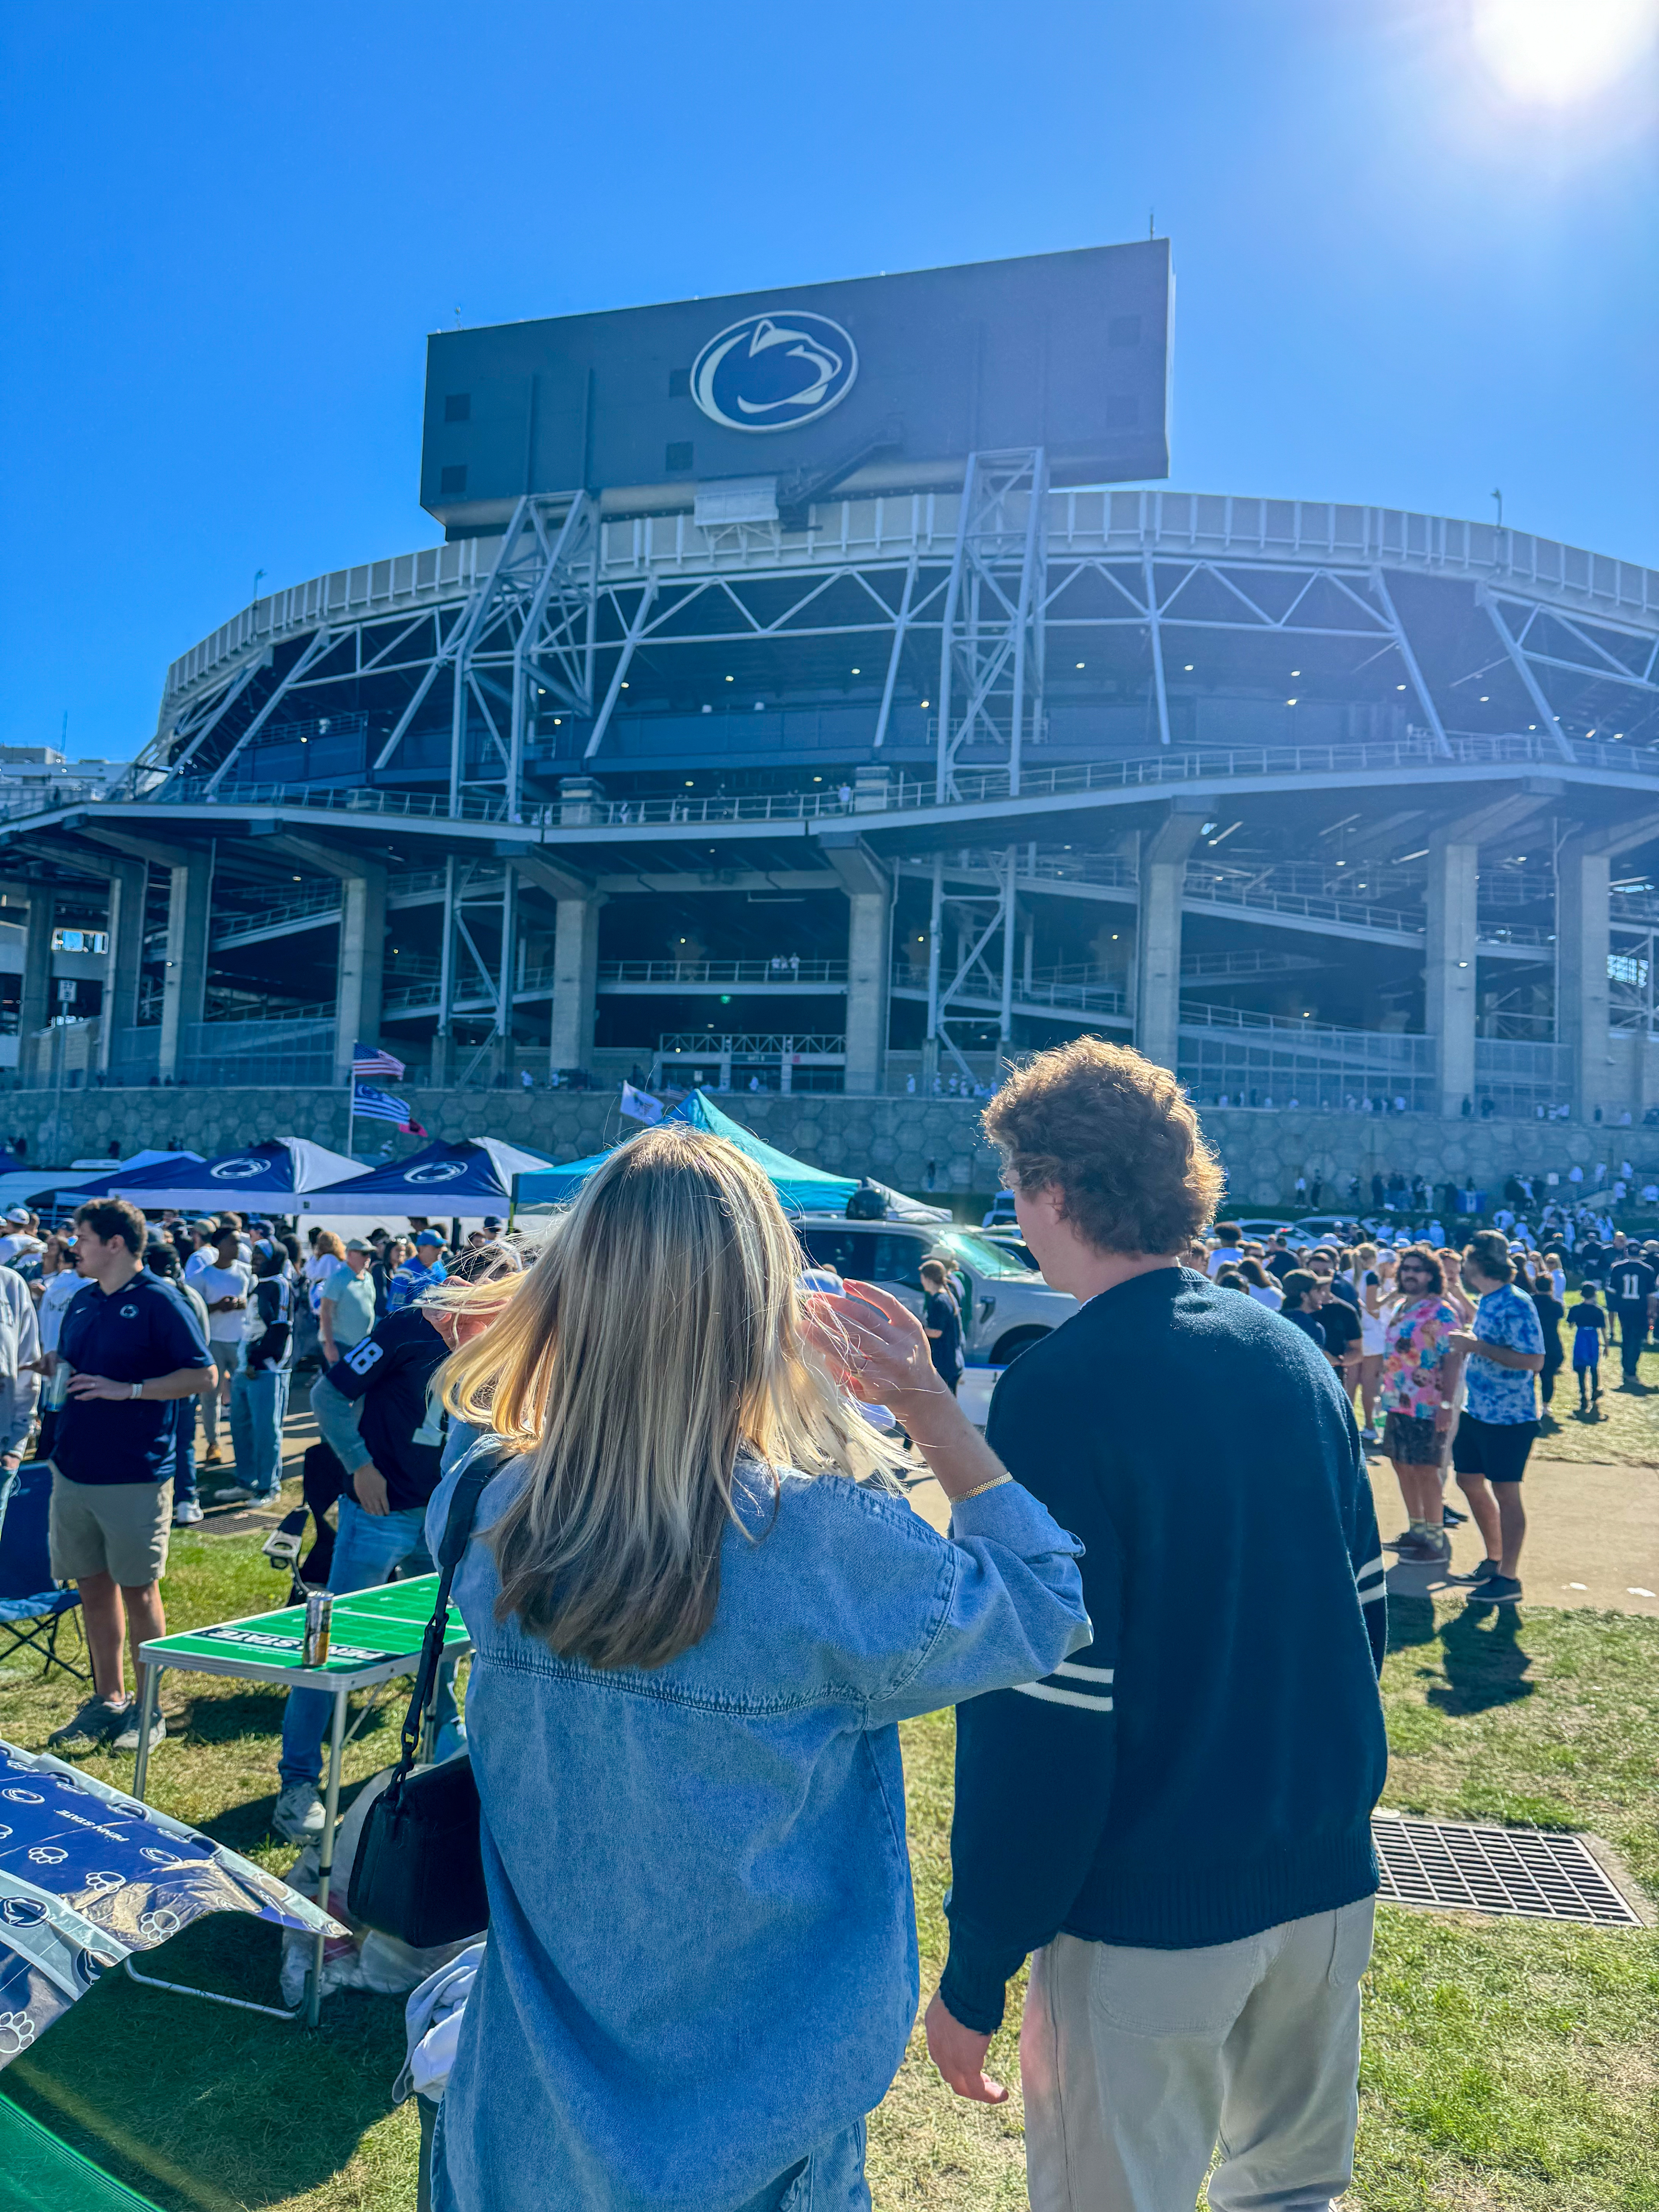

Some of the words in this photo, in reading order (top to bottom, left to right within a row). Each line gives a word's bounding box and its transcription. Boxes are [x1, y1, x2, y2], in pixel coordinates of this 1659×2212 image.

[1622, 1274, 1640, 1299] 11
[344, 1336, 383, 1374] 18
[208, 1630, 300, 1647] STATE
[55, 1810, 96, 1826] STATE
[91, 1825, 130, 1842] PENN
